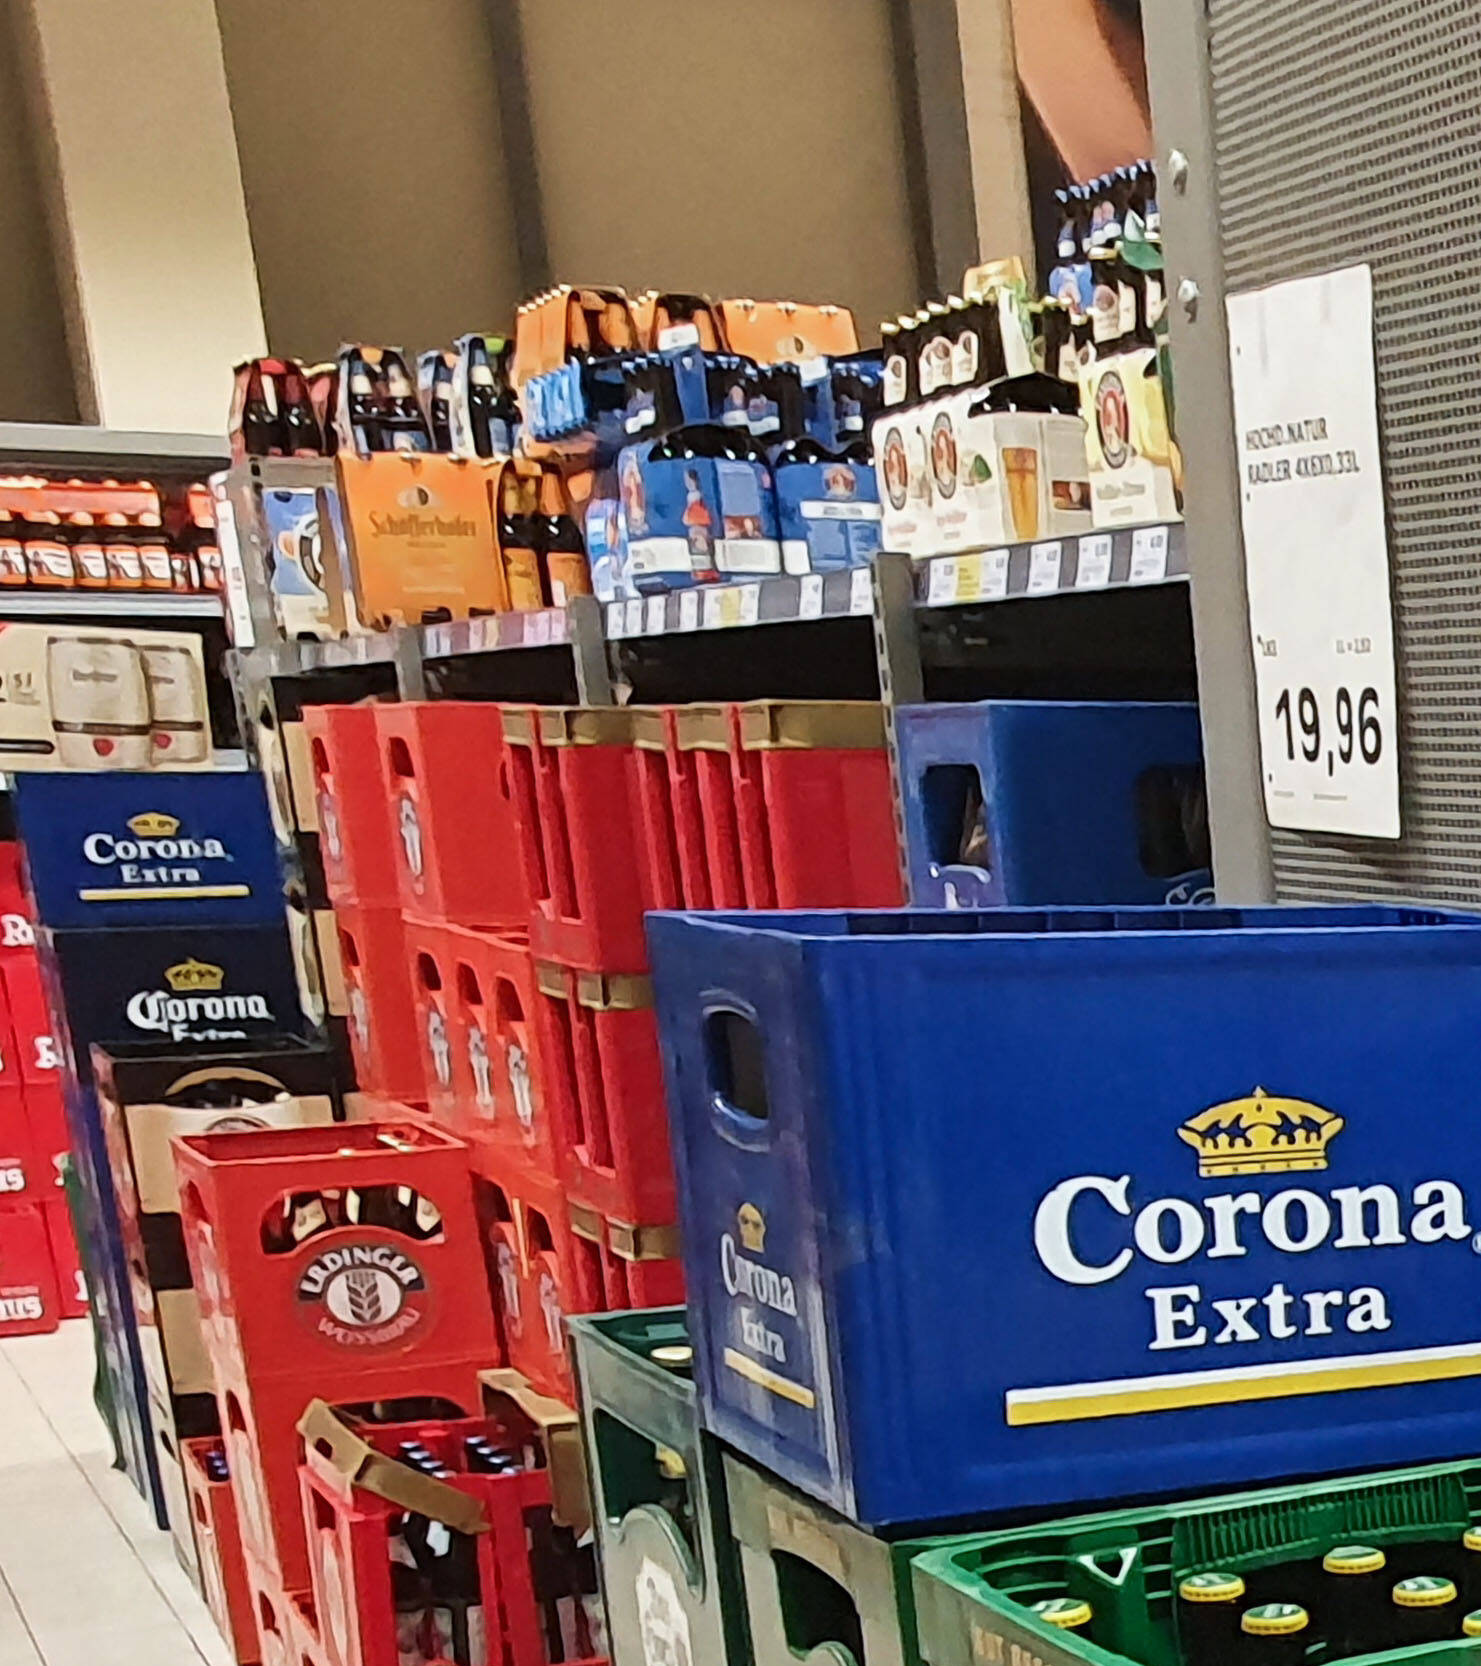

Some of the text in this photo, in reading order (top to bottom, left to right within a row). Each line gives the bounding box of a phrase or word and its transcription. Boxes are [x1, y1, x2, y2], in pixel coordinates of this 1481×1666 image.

[1275, 686, 1382, 777] 19,96
[83, 832, 226, 865] Corona
[120, 863, 201, 884] Extra
[126, 990, 276, 1033] Corona
[1033, 1174, 1471, 1286] Corona
[300, 1245, 419, 1294] ERDINGER
[719, 1227, 798, 1317] Corona
[738, 1303, 785, 1364] Extra
[1145, 1283, 1392, 1352] Extra
